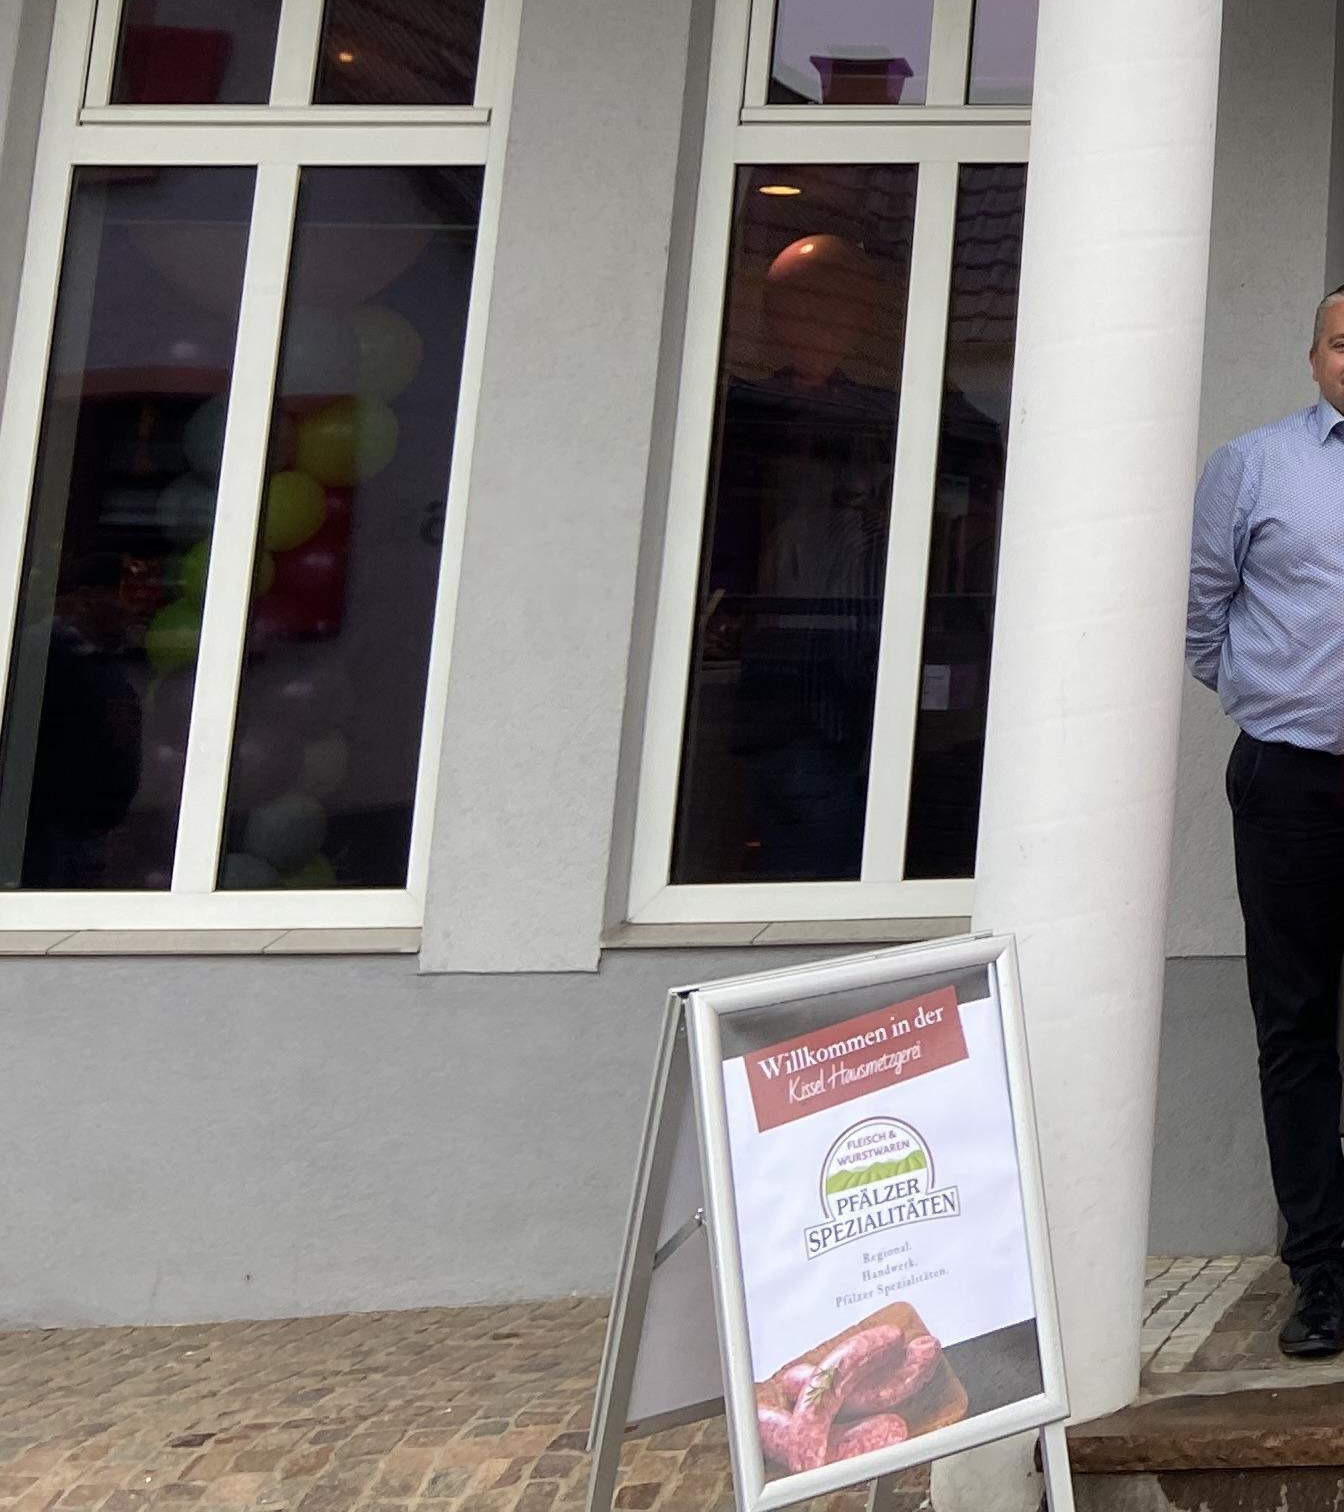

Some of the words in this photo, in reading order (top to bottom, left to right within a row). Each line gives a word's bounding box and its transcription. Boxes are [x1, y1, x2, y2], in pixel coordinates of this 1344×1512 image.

[757, 1025, 887, 1080] Willkommen
[890, 1015, 911, 1038] in
[914, 1005, 944, 1029] der
[788, 1067, 827, 1104] Kissel
[827, 1039, 923, 1089] Hausmetzgerei
[836, 1139, 910, 1166] WURSTWAREN
[847, 1131, 887, 1150] FLEISCH
[889, 1129, 897, 1139] &
[836, 1177, 921, 1216] PFÄLZER
[808, 1191, 957, 1254] SPEZIALITÄTEN
[862, 1240, 912, 1264] Regional.
[835, 1288, 874, 1309] Pfälzer
